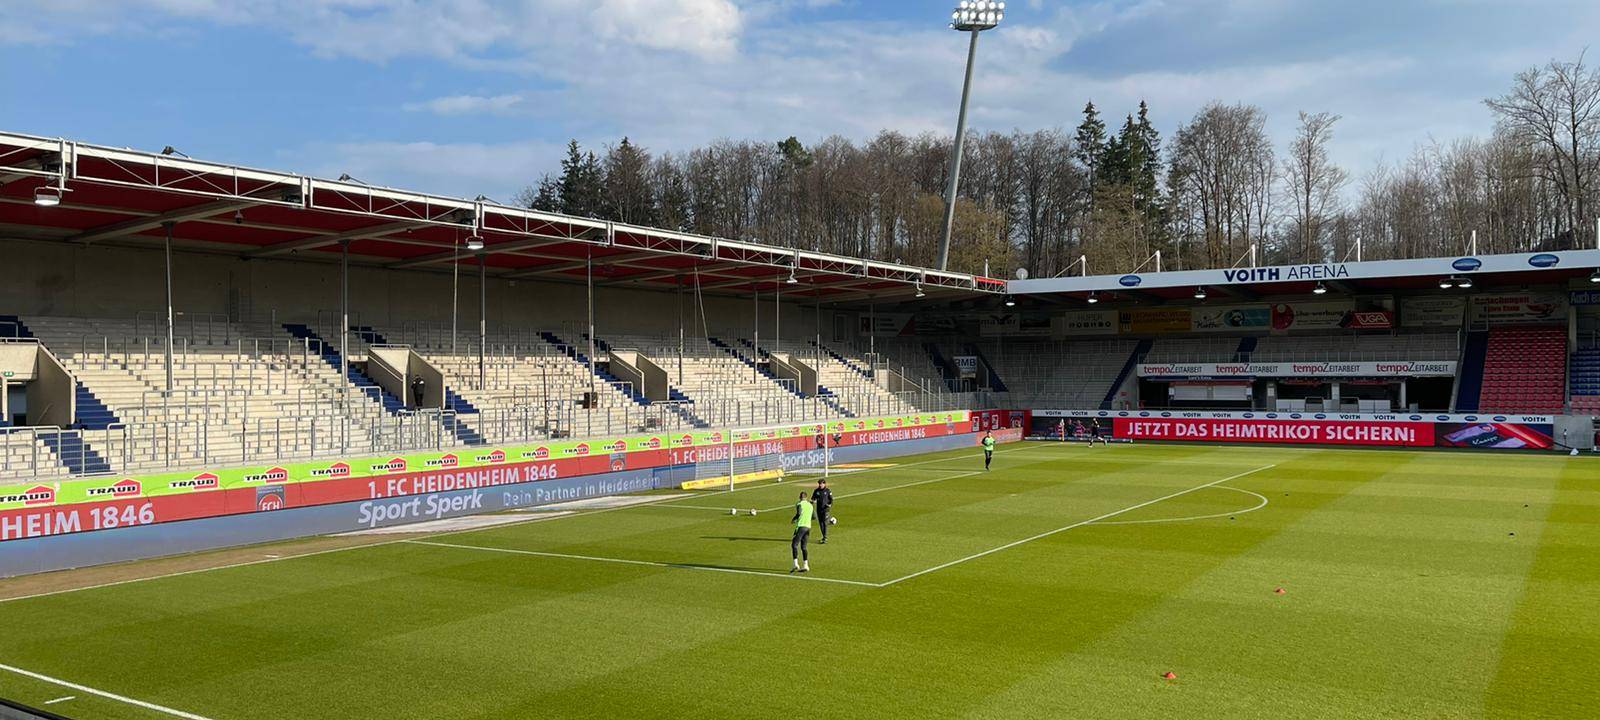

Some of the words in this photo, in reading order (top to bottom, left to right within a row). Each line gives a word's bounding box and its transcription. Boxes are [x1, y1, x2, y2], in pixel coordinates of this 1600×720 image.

[1223, 267, 1280, 283] VOITH
[1287, 264, 1350, 280] ARENA
[859, 433, 868, 443] FC
[869, 429, 910, 442] HEIDENHEIM
[911, 428, 926, 439] 1846
[1127, 421, 1173, 436] JETZT
[1176, 422, 1207, 437] DAS
[1211, 423, 1320, 440] HEIMTRIKOT
[1326, 425, 1415, 442] SICHERN!
[673, 453, 683, 464] 1.
[684, 450, 696, 463] FC
[763, 442, 783, 455] 1846
[807, 448, 834, 466] Spek
[368, 481, 381, 499] 1.
[387, 478, 407, 496] FC
[414, 465, 519, 493] HEIDENHEIM
[524, 463, 557, 482] 1846
[262, 501, 280, 511] FCH
[357, 497, 421, 527] Sport
[424, 489, 482, 517] Sperk
[503, 491, 532, 507] Dein
[536, 484, 581, 503] Partner
[585, 482, 596, 496] in
[599, 474, 660, 495] Heidenheim
[2, 509, 82, 540] HEIM
[89, 501, 155, 530] 1846
